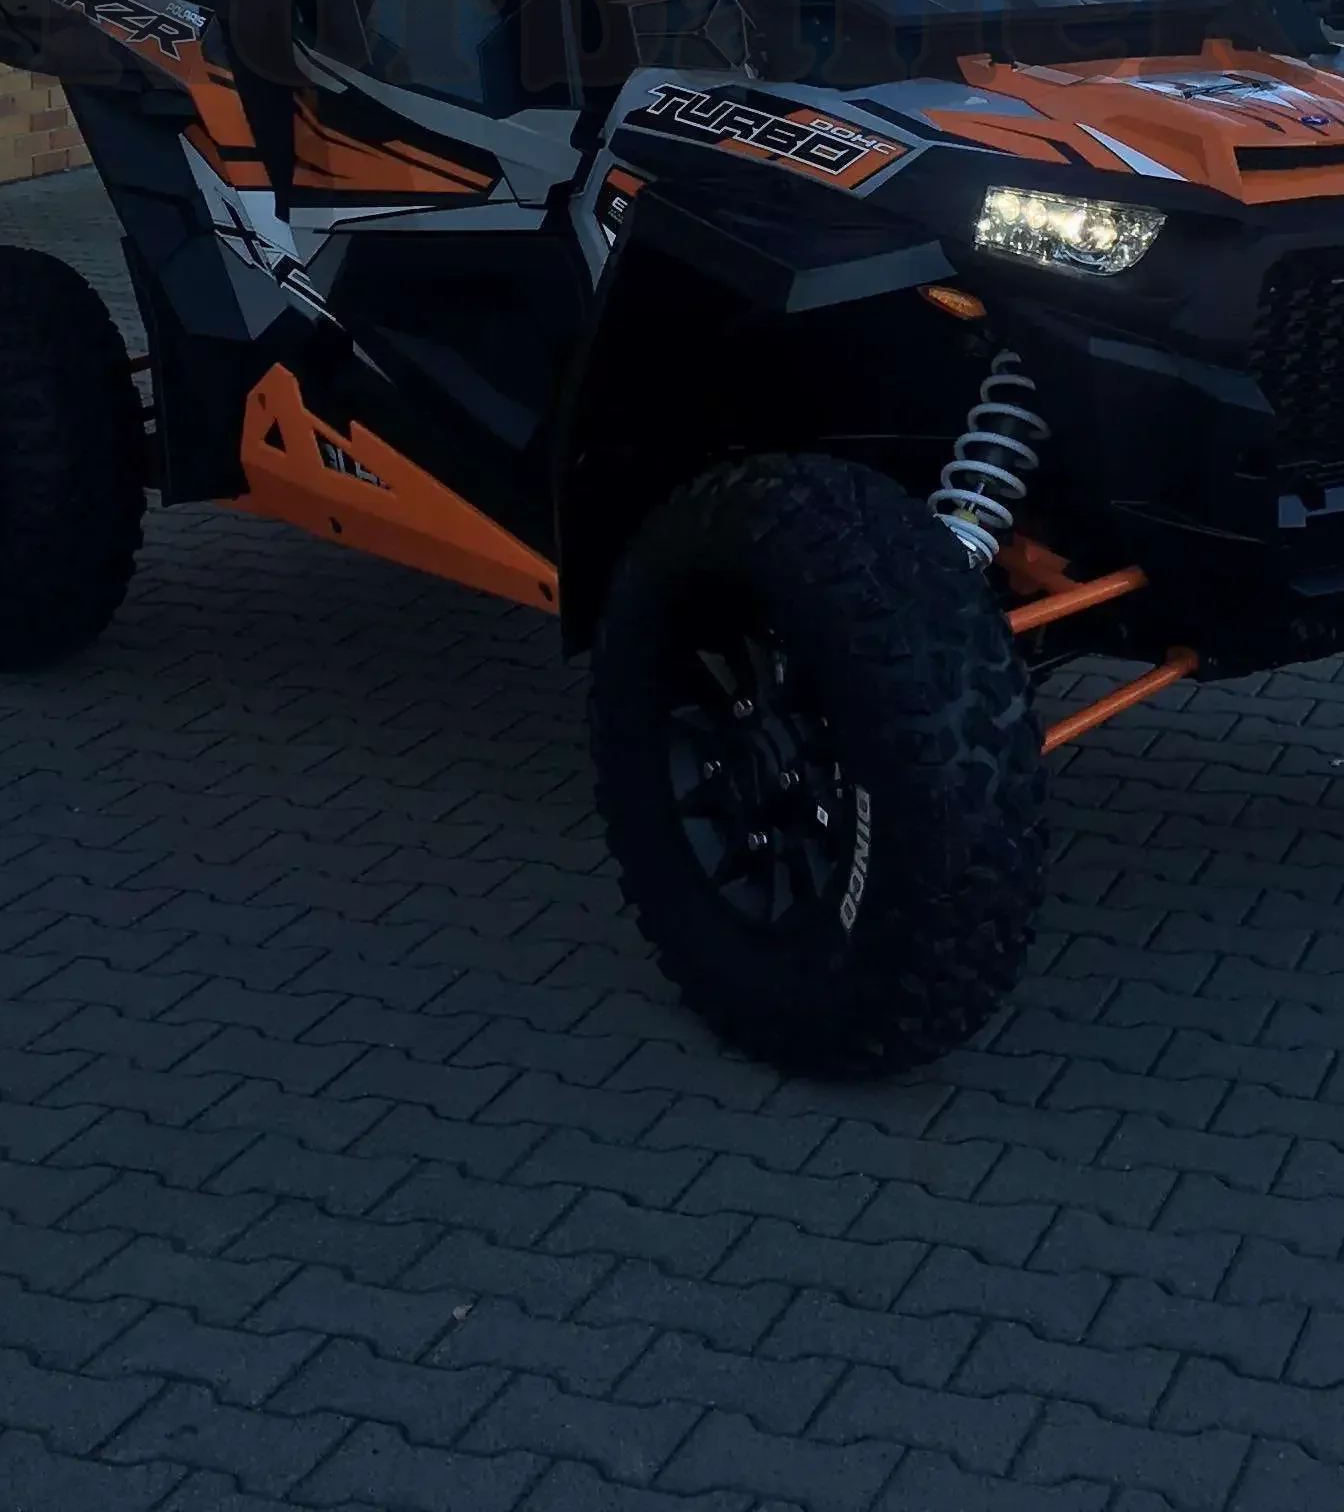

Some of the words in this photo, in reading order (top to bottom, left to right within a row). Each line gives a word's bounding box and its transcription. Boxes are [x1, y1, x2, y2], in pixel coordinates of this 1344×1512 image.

[165, 1, 207, 29] POLARIS
[648, 83, 870, 176] TURBO
[809, 117, 897, 155] DOHC
